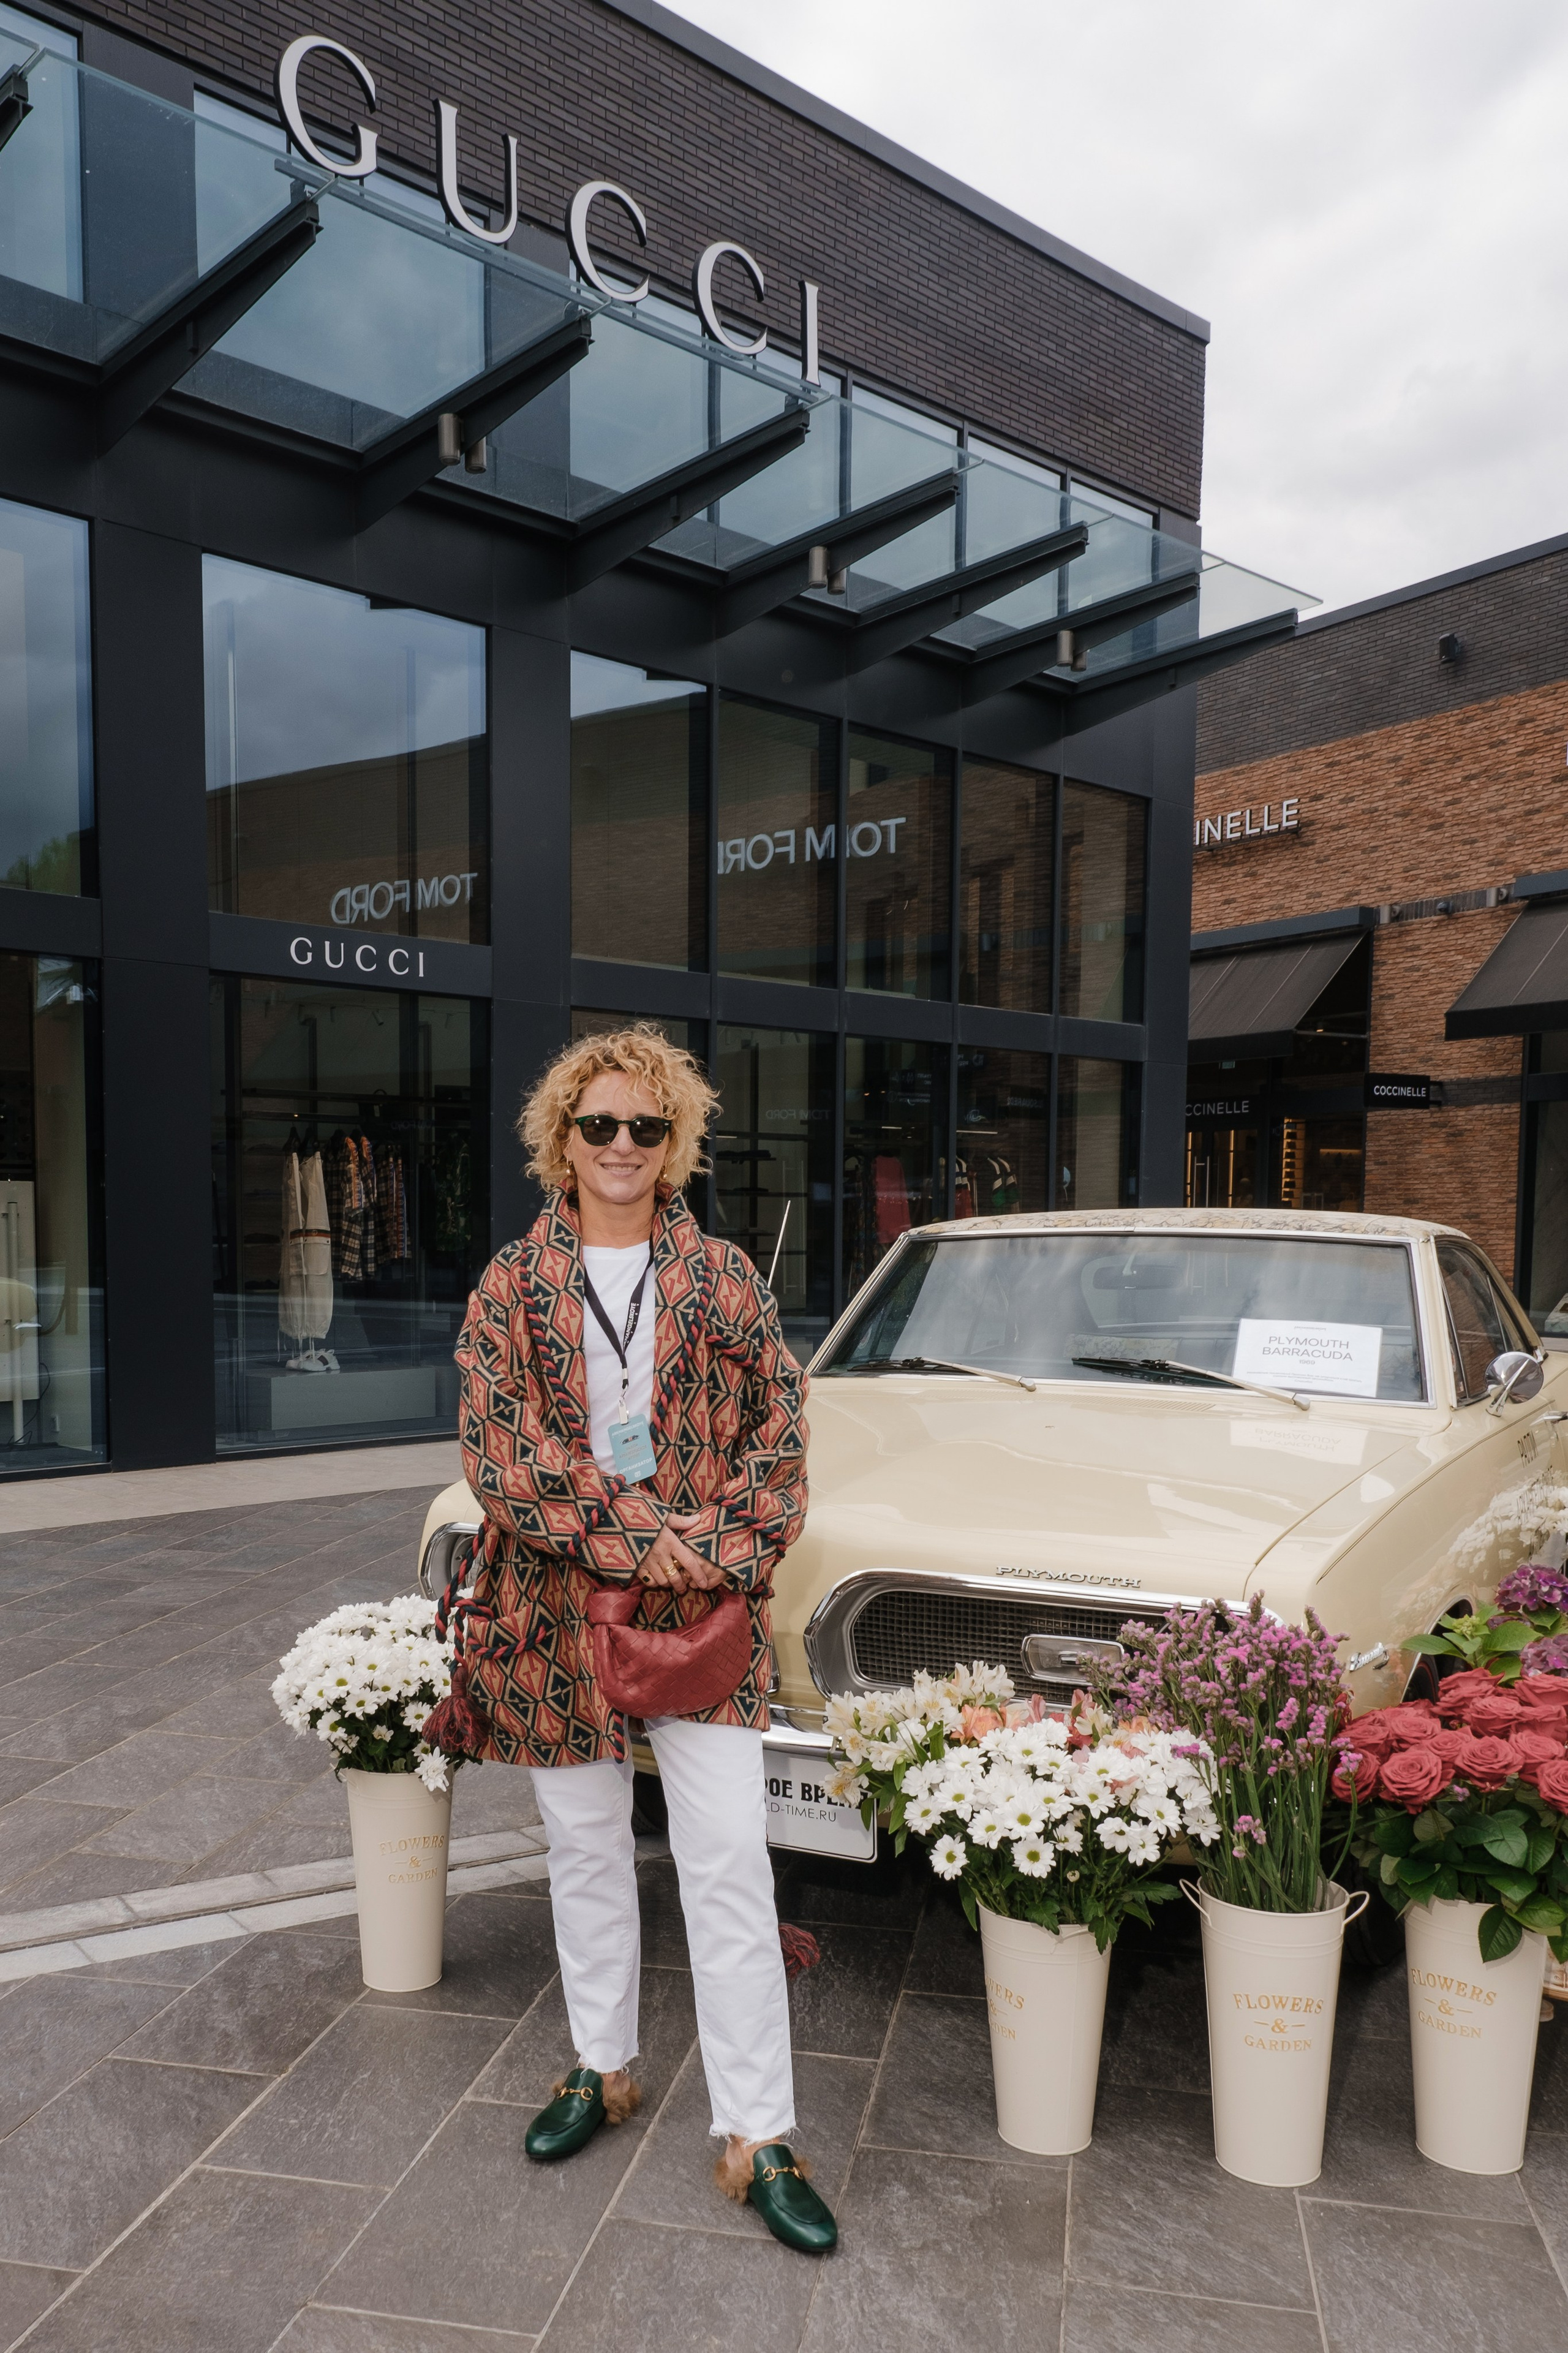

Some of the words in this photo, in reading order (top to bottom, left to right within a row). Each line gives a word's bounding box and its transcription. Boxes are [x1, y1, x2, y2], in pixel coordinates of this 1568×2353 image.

[276, 35, 821, 387] GUCCI
[1195, 798, 1299, 845] INELLE
[290, 937, 424, 978] GUCCI
[1373, 1085, 1427, 1097] COCCINELLE
[1185, 1100, 1249, 1116] CCINELLE
[1268, 1336, 1349, 1349] PLYMOUTH
[1262, 1347, 1353, 1361] BARRACUDA
[996, 1566, 1141, 1588] PLYMOUTH
[379, 1835, 444, 1856] FLOWERS
[409, 1856, 421, 1868] &
[388, 1868, 437, 1883] GARDEN
[1411, 1968, 1497, 2006] FLOWERS
[1233, 1993, 1324, 2014] FLOWERS
[1438, 1999, 1454, 2016] &
[1271, 2018, 1289, 2033] &
[1418, 2010, 1482, 2038] GARDEN
[1244, 2035, 1312, 2052] GARDEN
